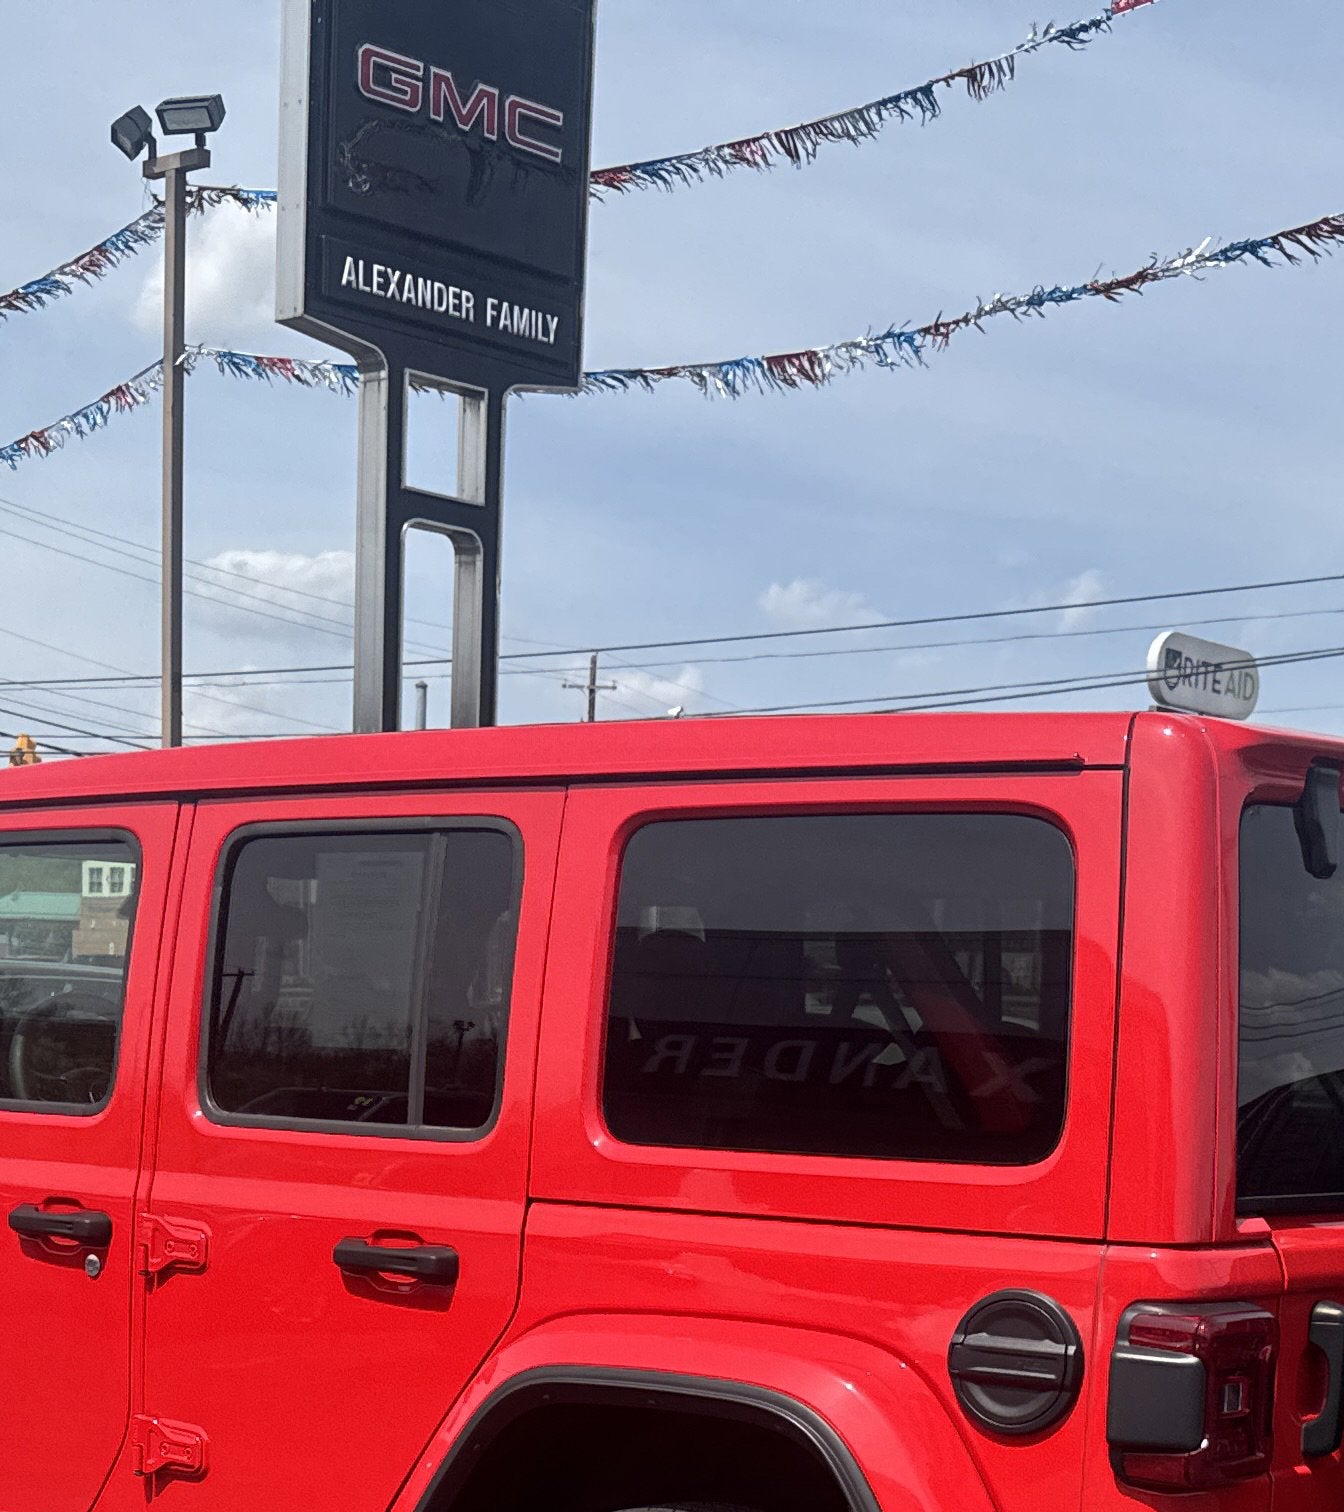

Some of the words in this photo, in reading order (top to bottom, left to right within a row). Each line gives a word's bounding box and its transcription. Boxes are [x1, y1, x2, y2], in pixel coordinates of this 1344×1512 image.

[357, 42, 564, 164] GMC
[341, 256, 474, 323] ALEXANDER
[486, 298, 558, 344] FAMILY
[1183, 656, 1223, 696] RITE
[1224, 668, 1255, 701] AID
